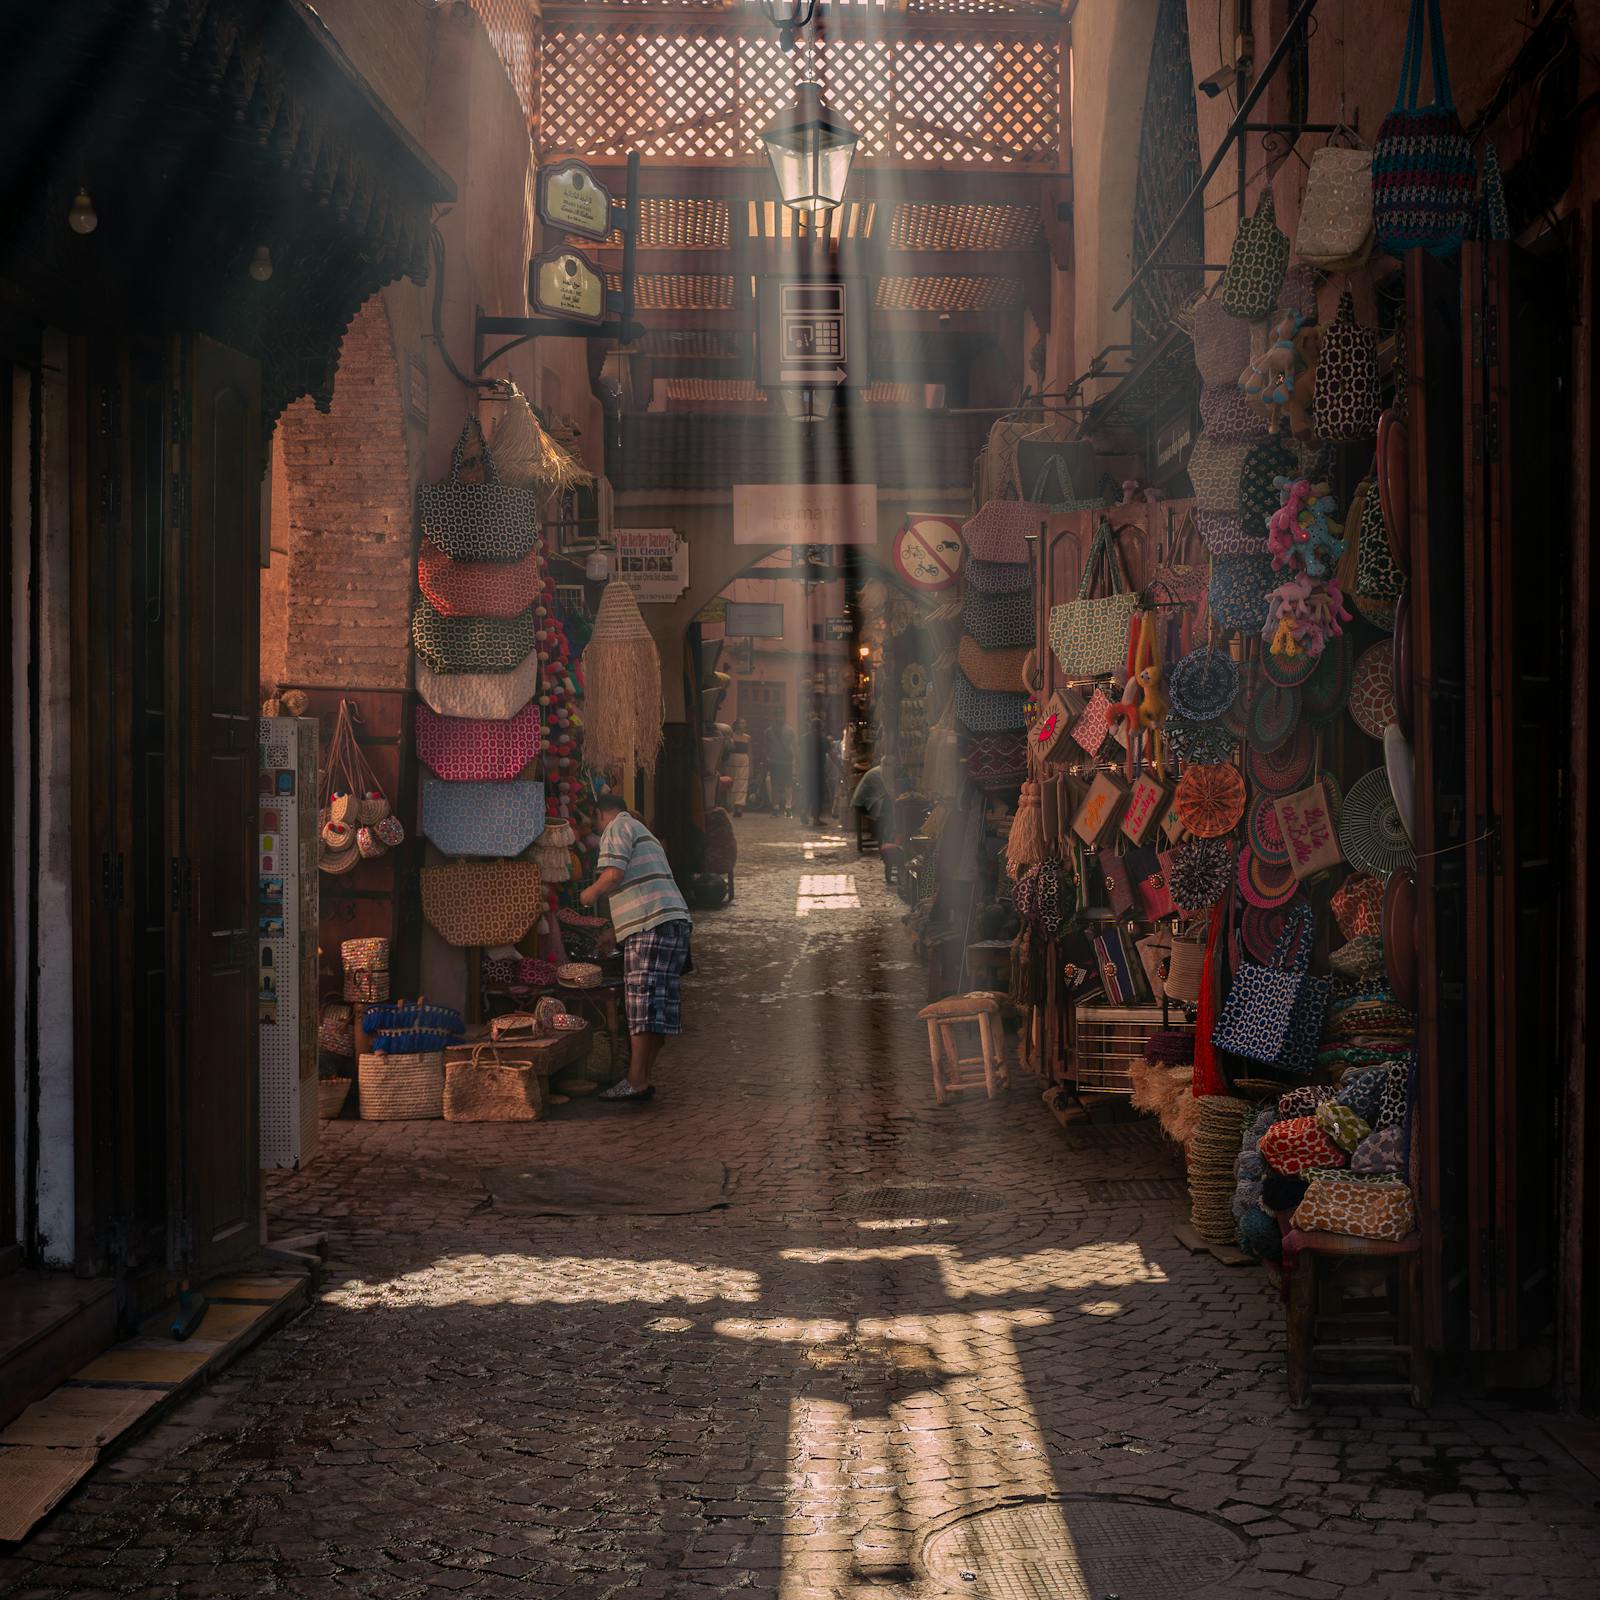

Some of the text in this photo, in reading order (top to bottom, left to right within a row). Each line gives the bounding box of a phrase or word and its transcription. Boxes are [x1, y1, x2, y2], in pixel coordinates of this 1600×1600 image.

[1281, 806, 1313, 866] est Belle
[1304, 807, 1330, 849] La Vie
